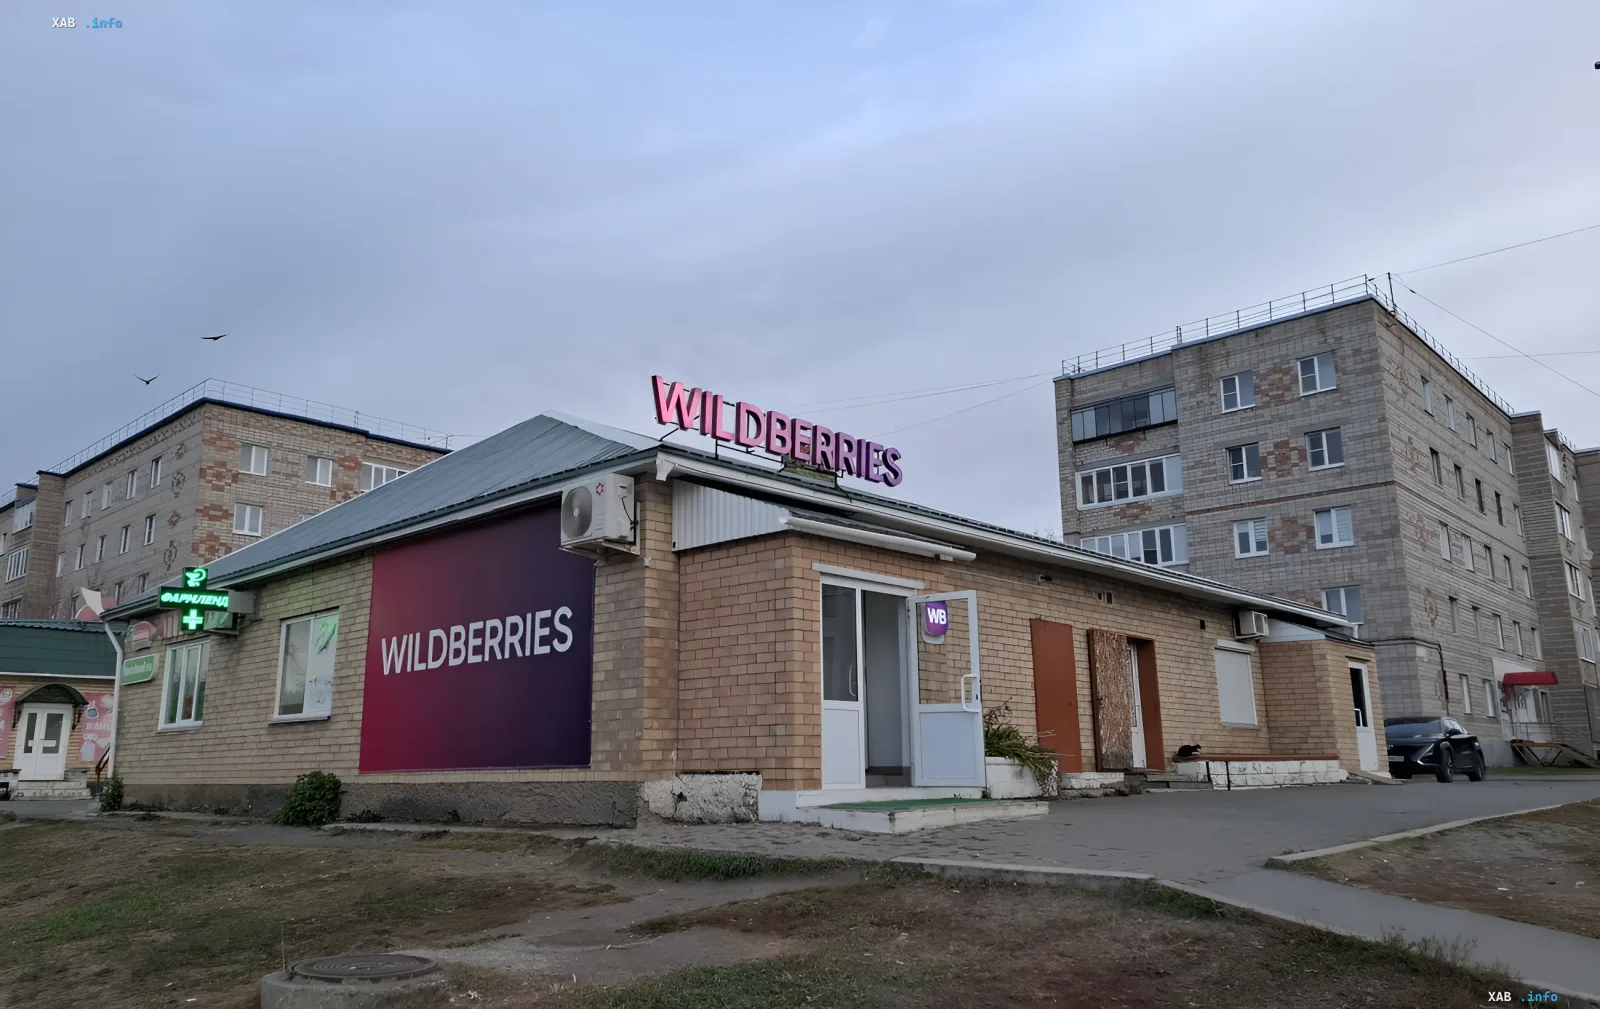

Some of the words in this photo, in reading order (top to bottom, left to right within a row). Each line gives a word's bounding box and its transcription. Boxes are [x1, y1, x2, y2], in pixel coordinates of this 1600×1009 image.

[651, 375, 903, 487] WILDBERRIES
[381, 605, 574, 676] WILDBERRIES
[926, 607, 947, 625] WB
